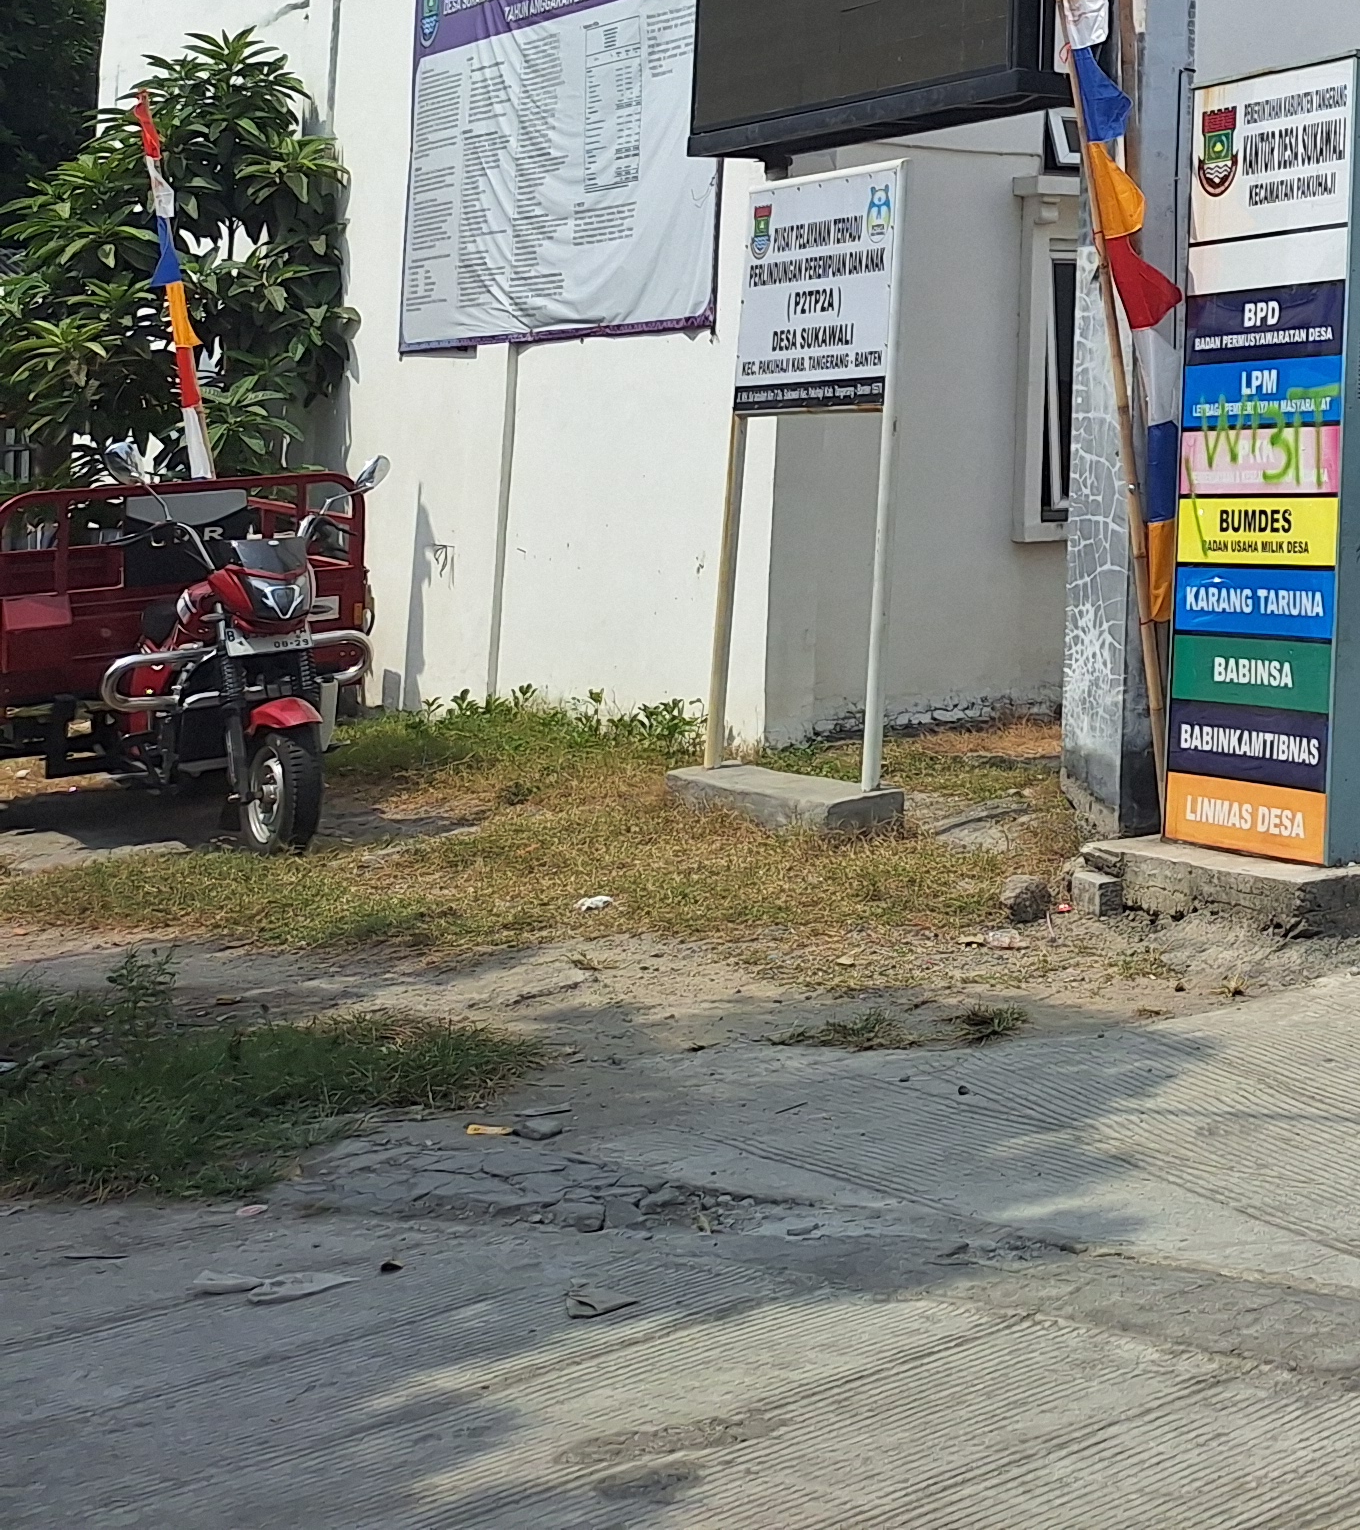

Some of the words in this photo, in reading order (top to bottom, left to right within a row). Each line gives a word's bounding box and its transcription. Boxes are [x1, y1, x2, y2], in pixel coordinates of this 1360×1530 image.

[504, 0, 530, 23] TAHUN
[1283, 91, 1314, 118] KABUPATEN
[1315, 83, 1348, 112] TANGERANG
[1242, 130, 1276, 177] KANTOR
[1277, 125, 1299, 171] DESA
[1300, 117, 1347, 167] SUKAWALI
[1248, 178, 1295, 207] KECAMATAN
[1295, 172, 1337, 201] PAKUHAJI
[772, 226, 794, 254] PUSAT
[794, 220, 831, 252] PELAYANAN
[832, 214, 864, 246] TERPADU
[748, 257, 802, 289] PERLINDUNGAN
[803, 252, 848, 282] PEREMPUAN
[849, 249, 863, 275] DAN
[863, 247, 886, 274] ANAK
[1243, 300, 1280, 328] BPD
[771, 329, 798, 353] DESA
[799, 322, 854, 350] SUKAWALI
[1193, 336, 1221, 351] BADAN
[1221, 328, 1308, 349] PERMUSYAWARATAN
[1307, 326, 1333, 342] DESA
[741, 360, 757, 377] KEC.
[757, 356, 791, 376] PAKUHAJI
[791, 354, 807, 373] KAB.
[807, 351, 850, 372] TANGERANG
[853, 349, 883, 369] BANTEN
[1240, 369, 1278, 396] LPM
[1280, 396, 1332, 413] MASYARAAT
[1218, 508, 1293, 534] BUMDES
[1231, 540, 1259, 553] USAHA
[1261, 540, 1284, 554] MILIK
[1286, 541, 1310, 554] DESA
[1185, 586, 1253, 613] KARANG
[1257, 589, 1324, 617] TARUNA
[1213, 656, 1294, 688] BABINSA
[1180, 723, 1320, 766] BABINKAMTIBNAS
[1185, 795, 1253, 830] LINMAS
[1257, 806, 1306, 839] DESA
